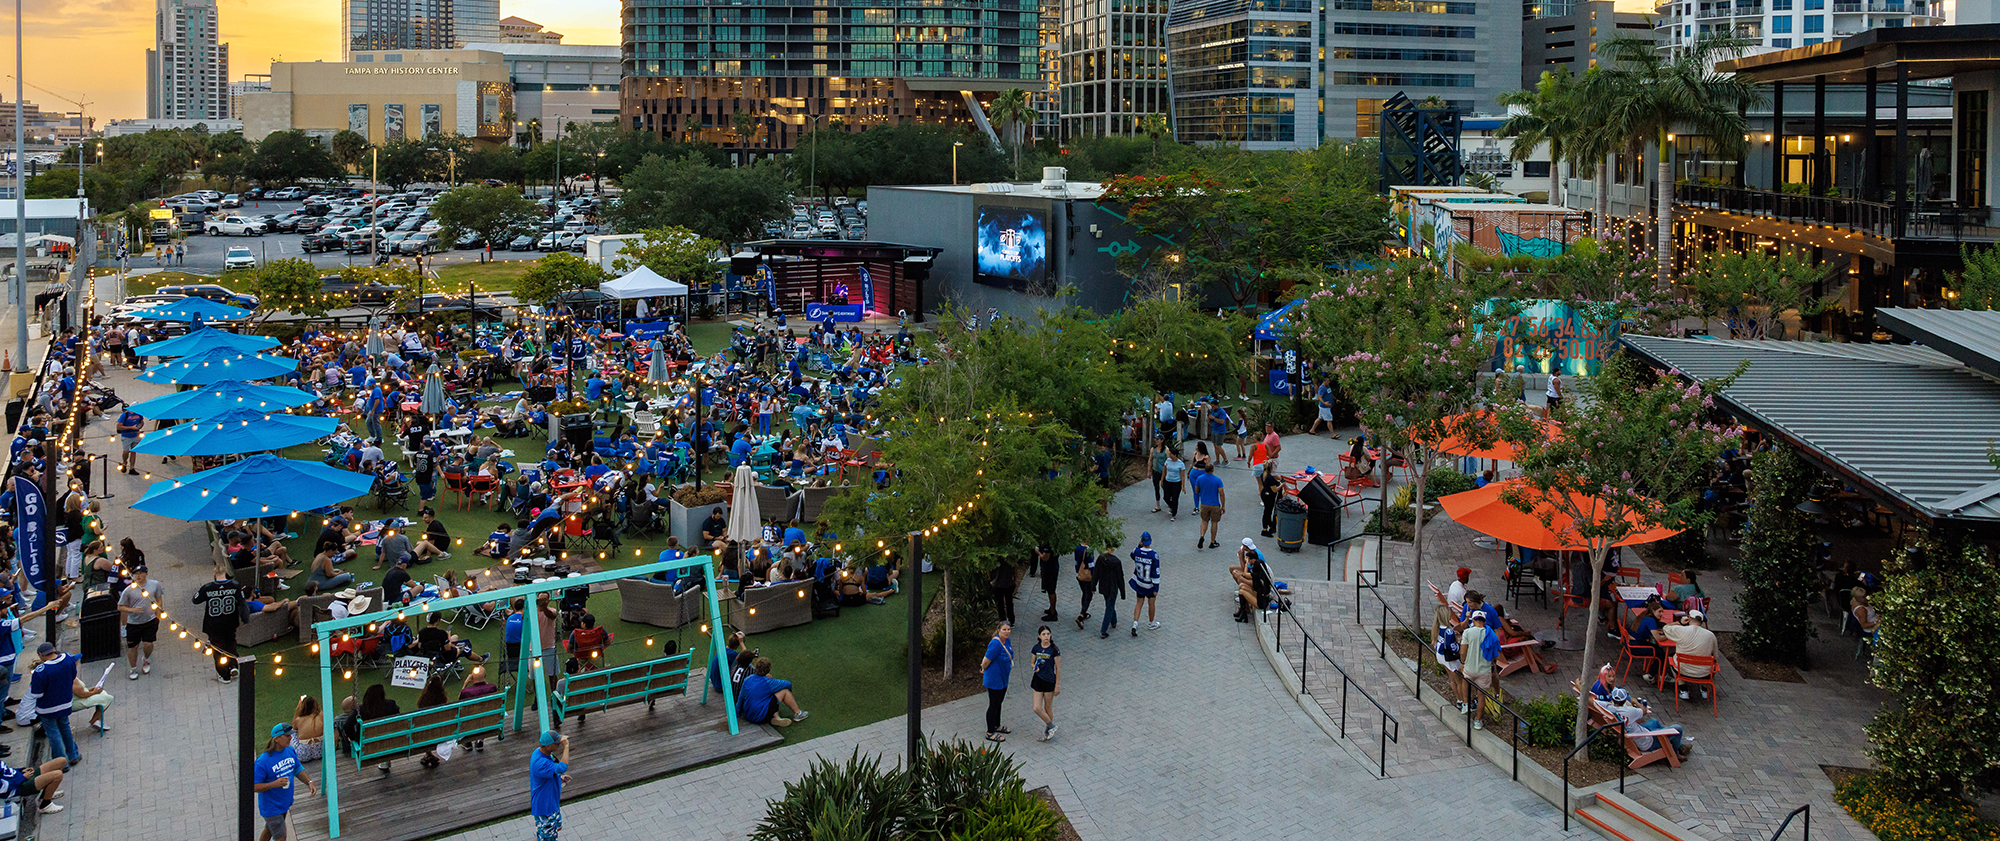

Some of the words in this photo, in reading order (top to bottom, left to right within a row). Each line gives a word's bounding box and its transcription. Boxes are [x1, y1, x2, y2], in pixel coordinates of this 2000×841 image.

[373, 67, 389, 75] BAY
[391, 67, 425, 75] HISTORY
[427, 66, 459, 75] CENTER
[25, 493, 38, 516] GO
[110, 564, 120, 573] 91
[1135, 562, 1151, 582] 91
[208, 595, 236, 617] 88
[732, 667, 744, 683] 6
